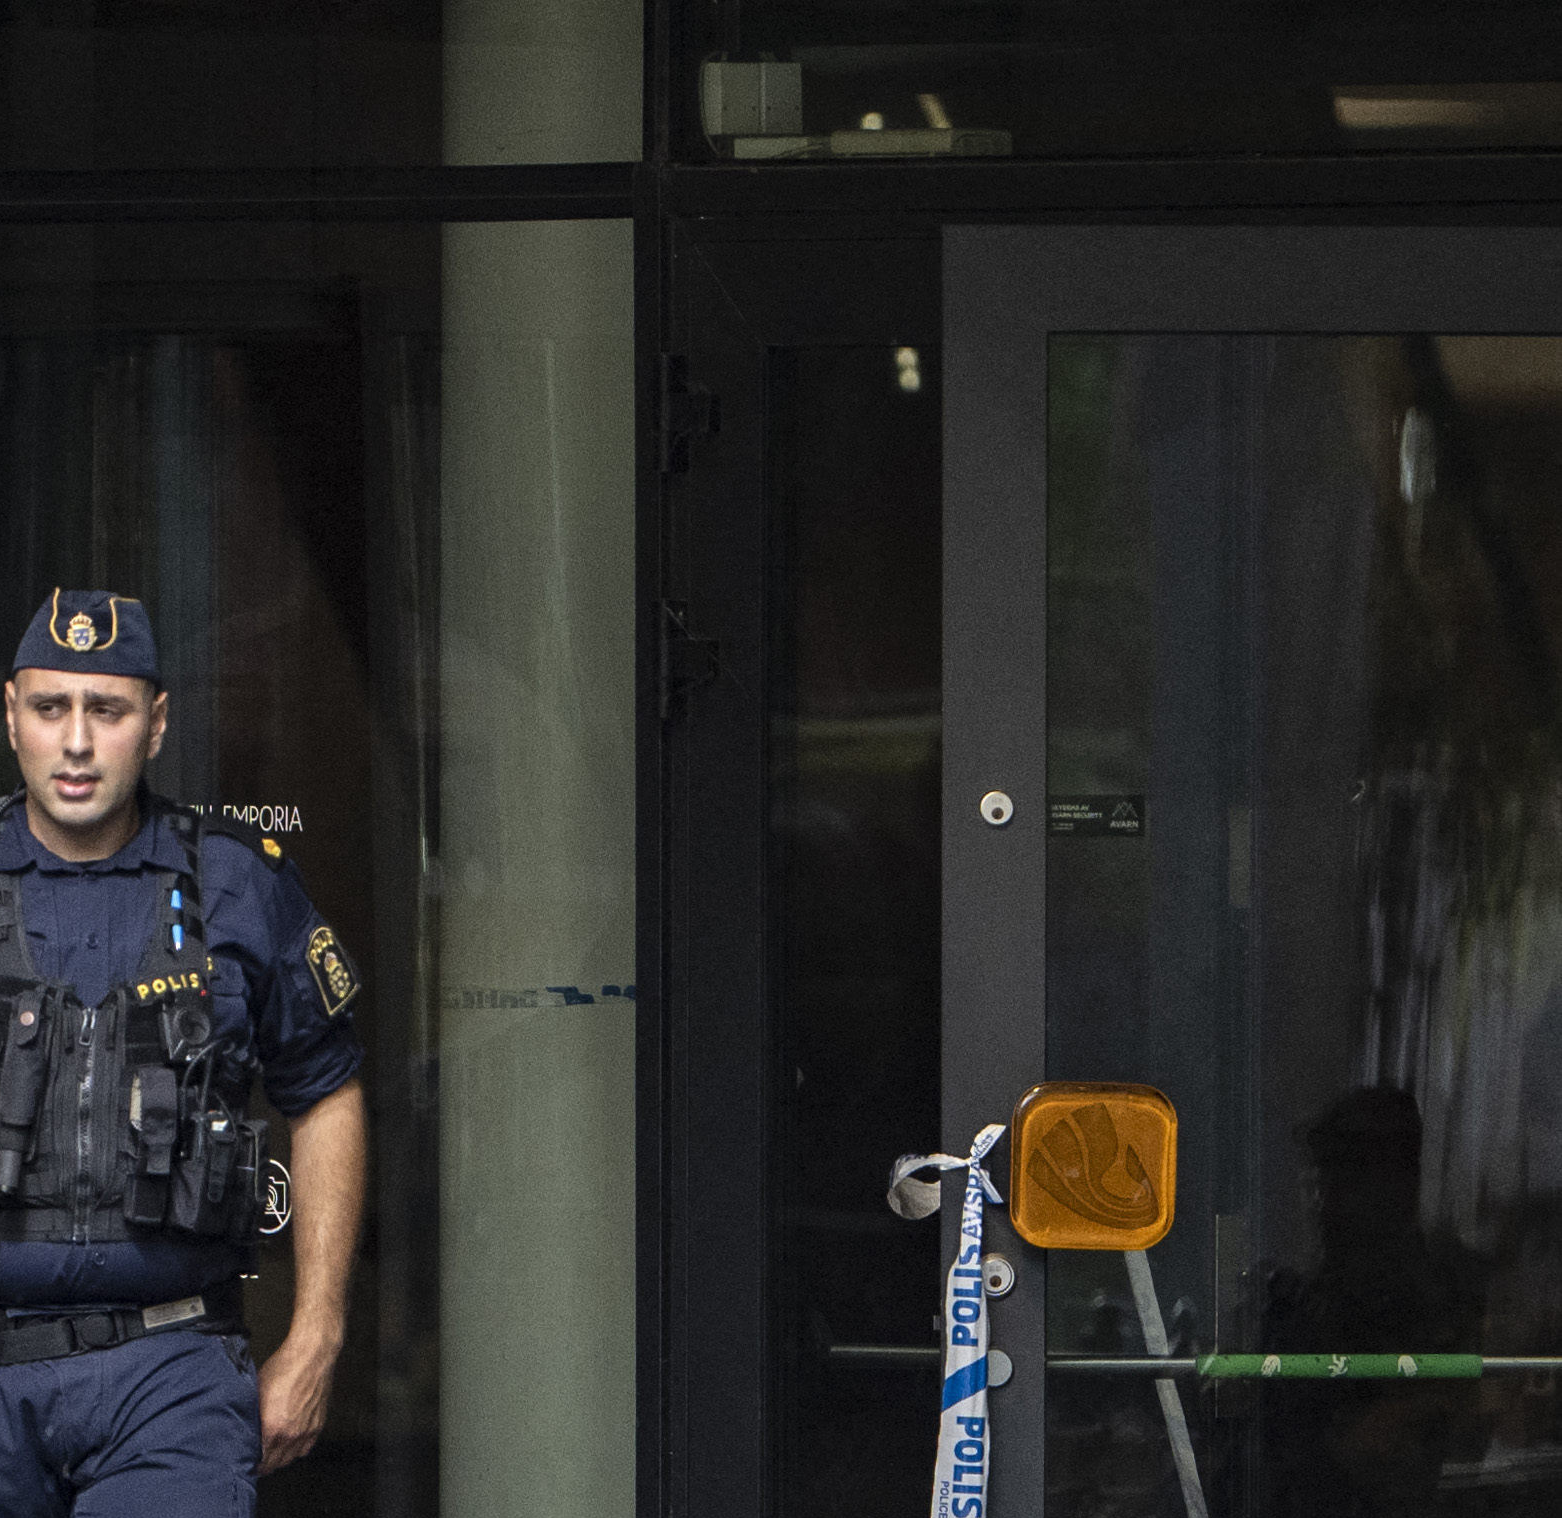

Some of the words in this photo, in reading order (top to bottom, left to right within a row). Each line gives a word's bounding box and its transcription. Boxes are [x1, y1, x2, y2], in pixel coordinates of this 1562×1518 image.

[1110, 820, 1139, 828] AVARN
[136, 972, 200, 1000] POLIS
[951, 1244, 983, 1347] POLIS
